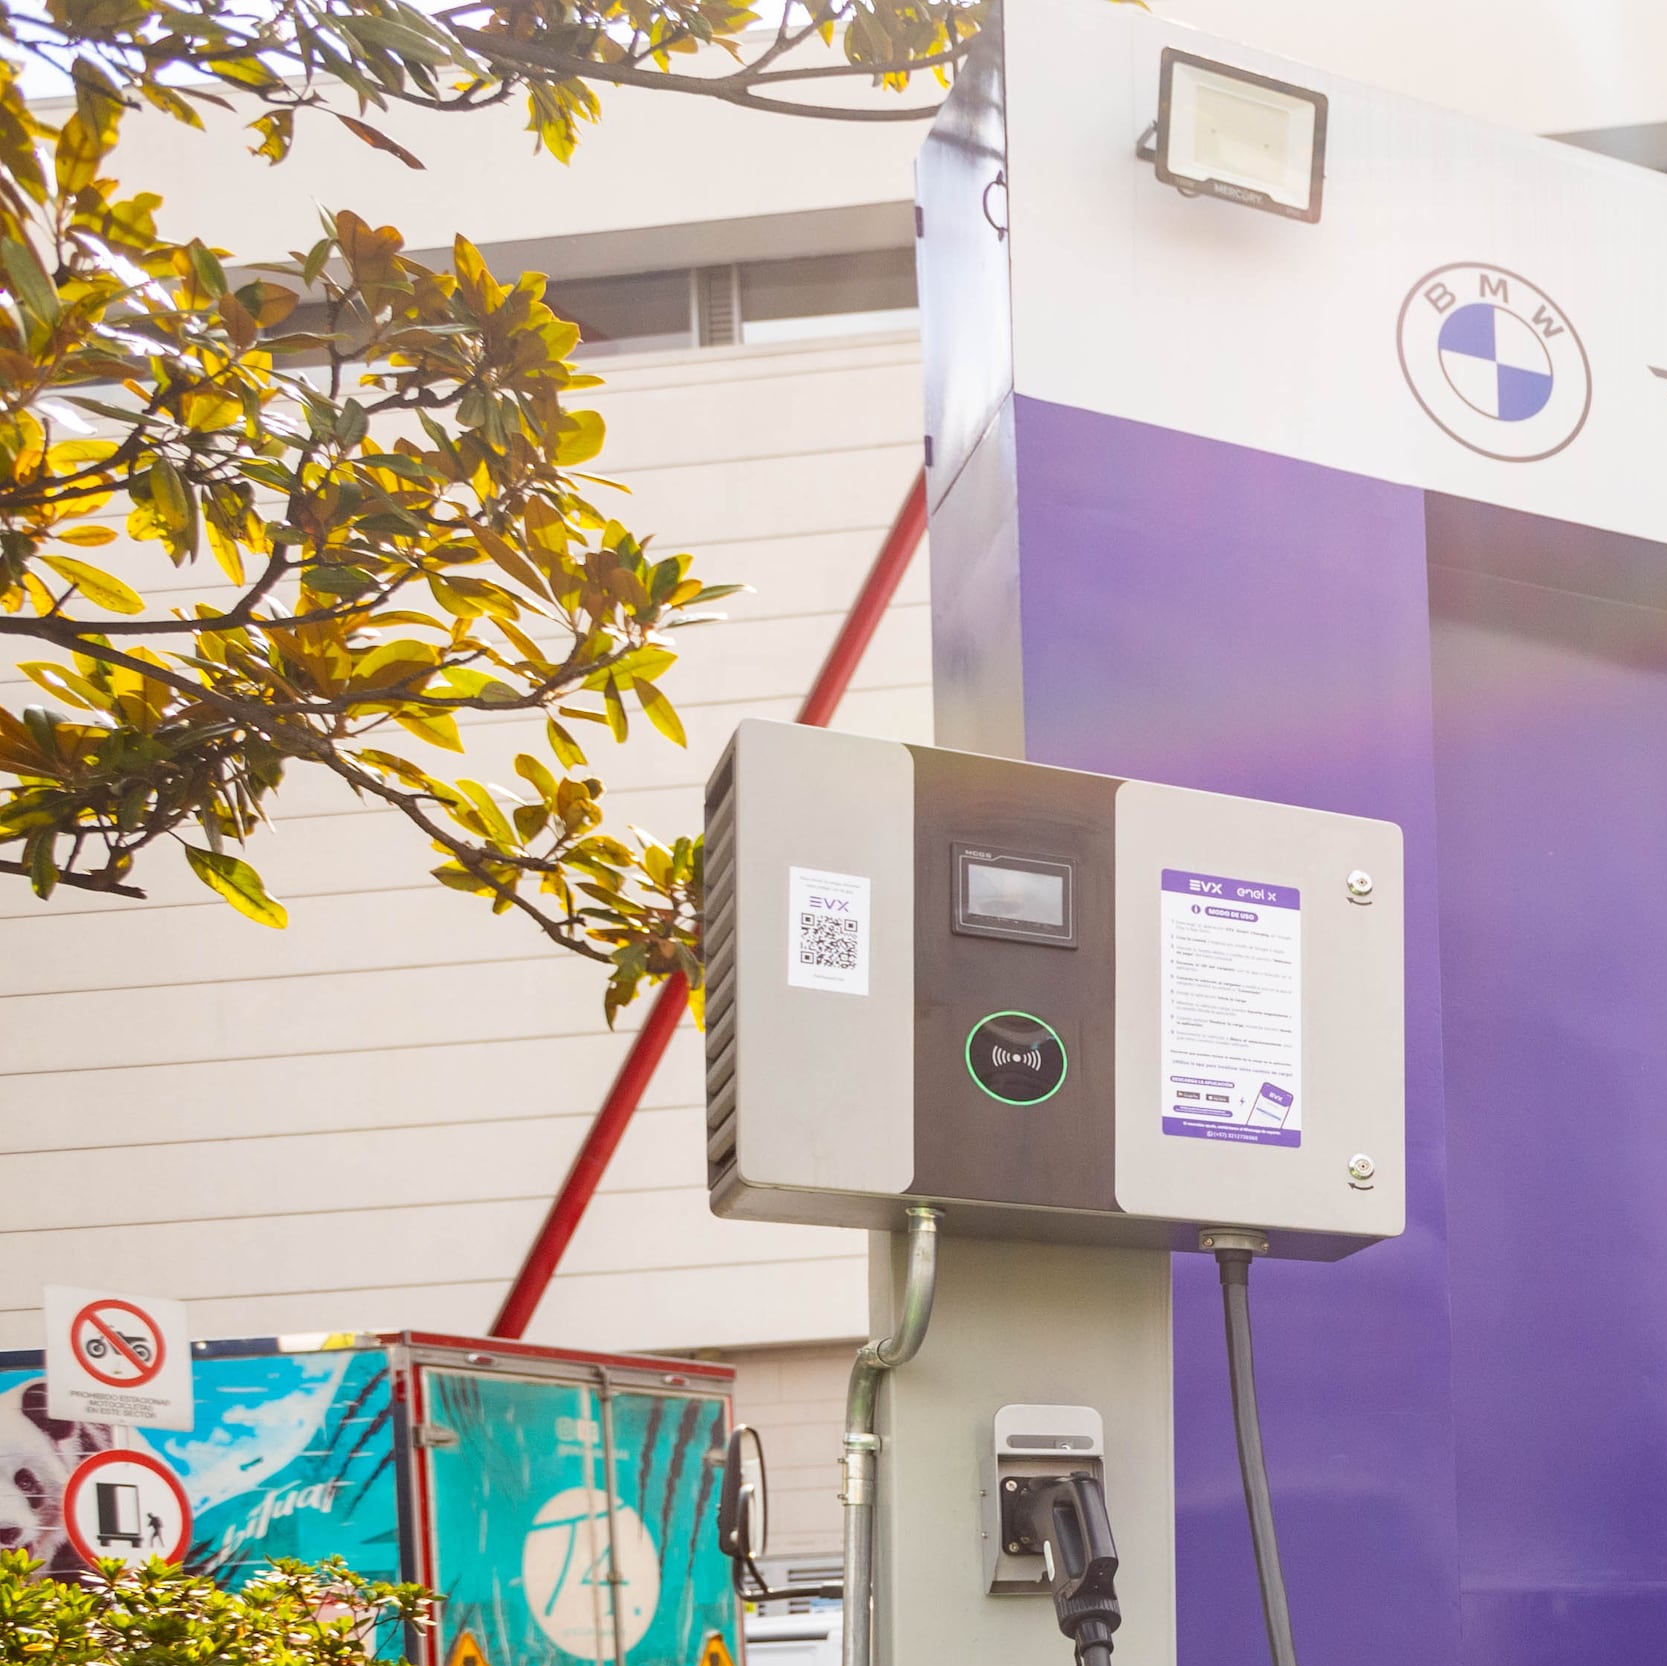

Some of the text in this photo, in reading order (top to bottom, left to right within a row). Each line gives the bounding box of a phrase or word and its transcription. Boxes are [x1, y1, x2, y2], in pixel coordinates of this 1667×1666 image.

[1423, 272, 1566, 341] BMW
[1189, 879, 1223, 895] EVX
[1236, 887, 1265, 900] enel
[809, 895, 849, 912] EVX
